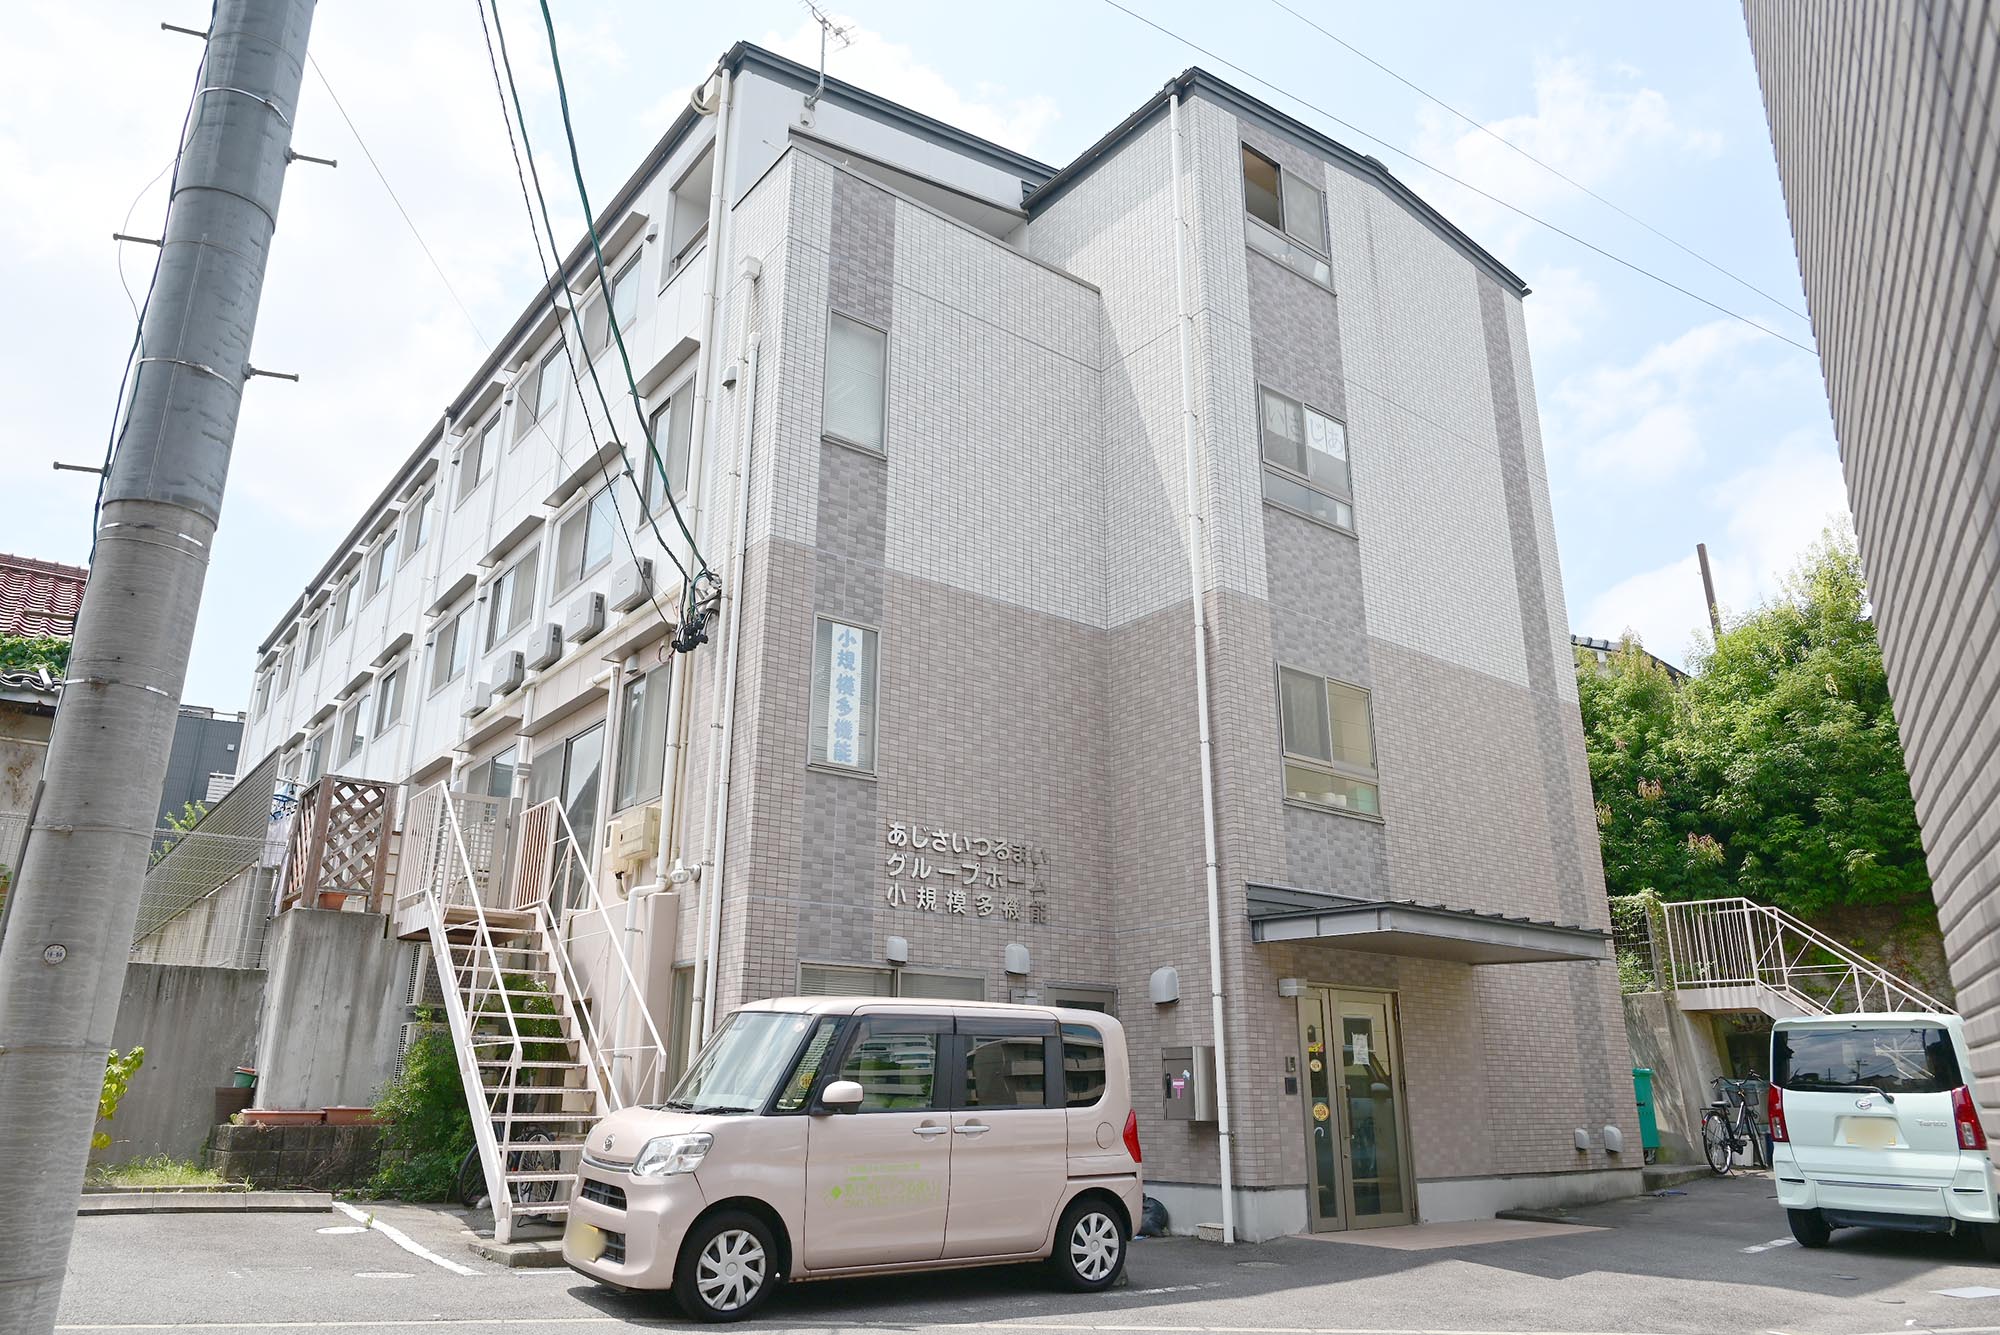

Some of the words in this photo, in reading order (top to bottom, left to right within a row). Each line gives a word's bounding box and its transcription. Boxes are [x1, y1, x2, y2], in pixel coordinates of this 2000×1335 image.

[833, 628, 858, 763] 小規模多機能
[887, 821, 1048, 865] あじさいつるまい
[887, 852, 1048, 896] グループホーム
[887, 882, 1048, 924] 小規模多機能
